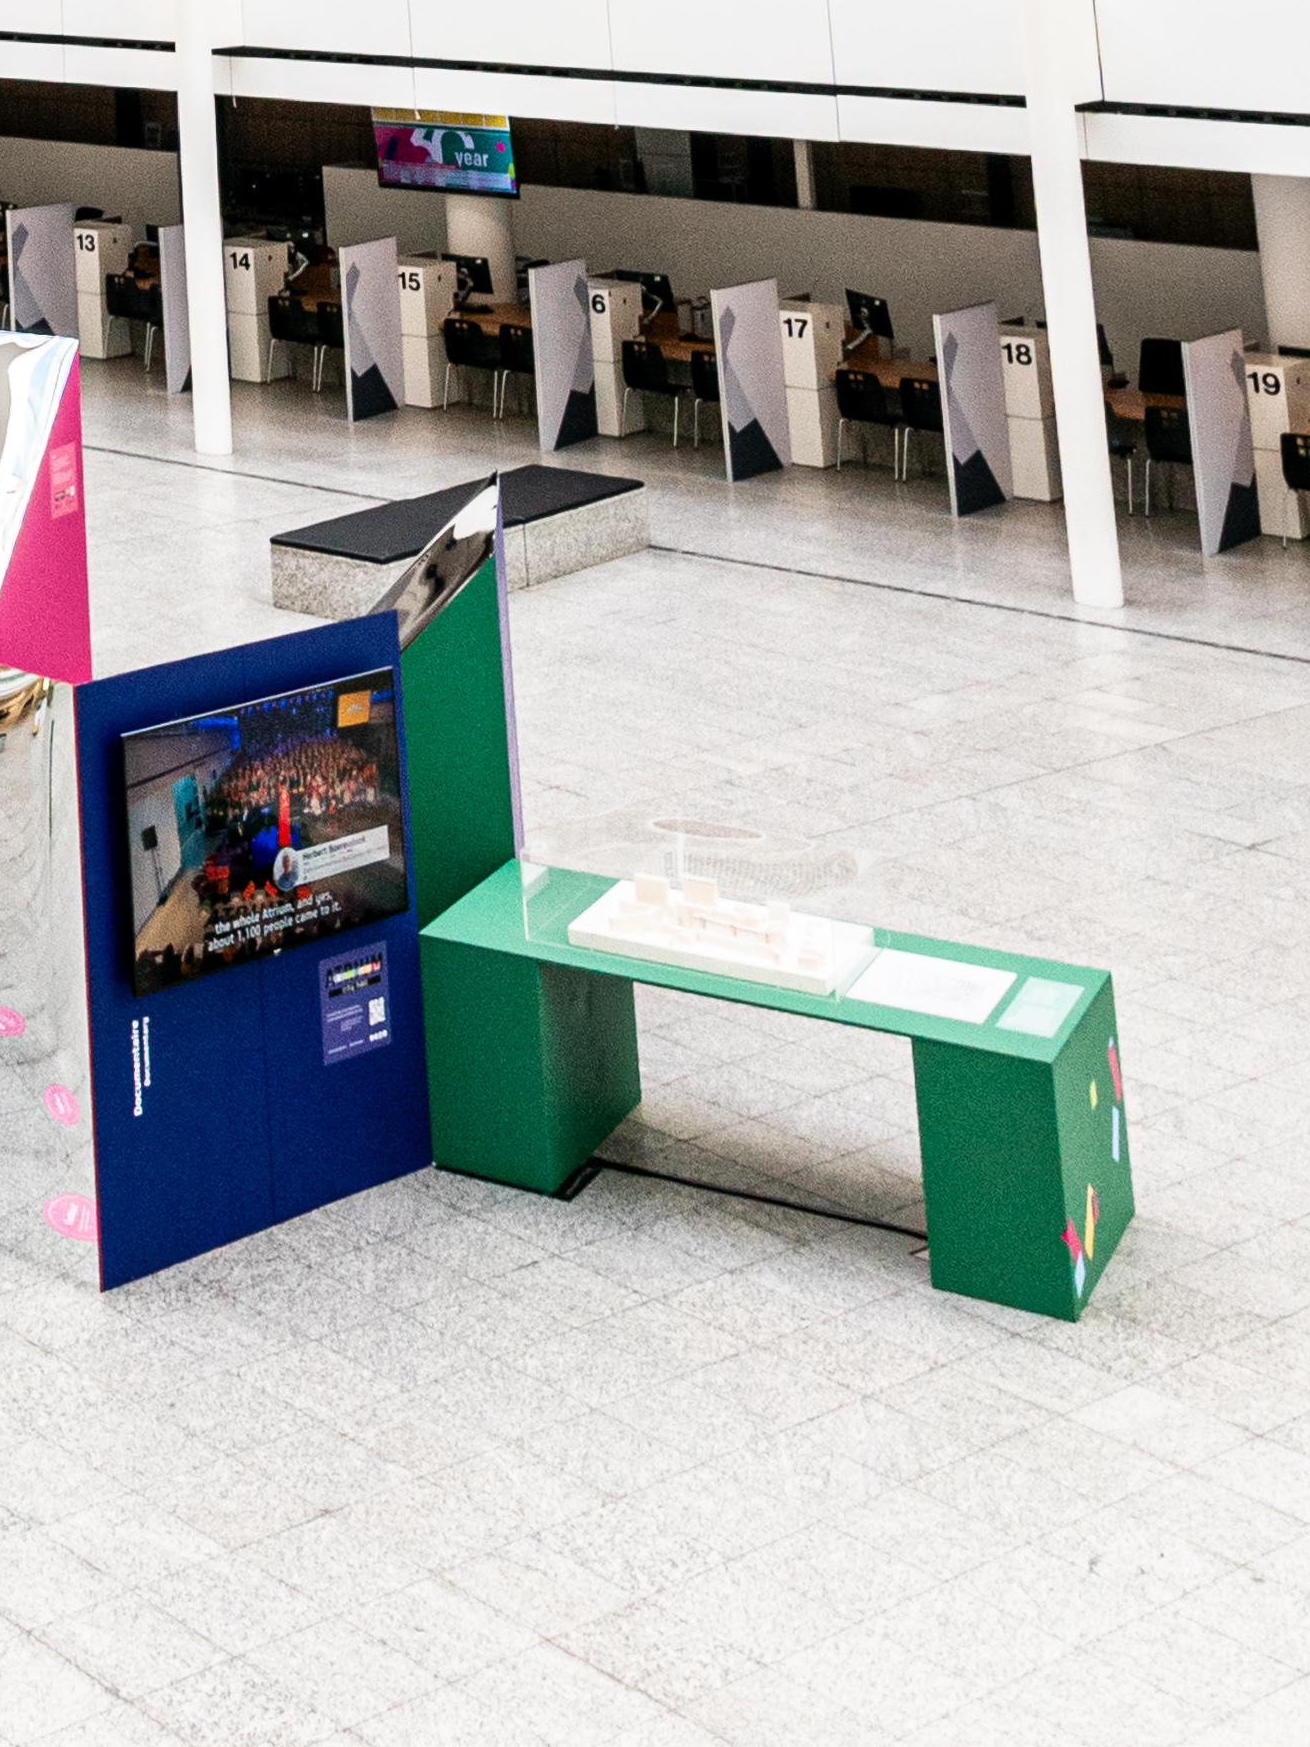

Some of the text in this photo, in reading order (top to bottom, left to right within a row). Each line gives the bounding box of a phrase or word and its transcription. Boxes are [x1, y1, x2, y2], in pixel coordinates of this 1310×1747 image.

[454, 150, 489, 168] year
[76, 233, 96, 252] 13
[229, 251, 251, 271] 14
[398, 271, 421, 292] 15
[782, 317, 808, 339] 17
[1001, 343, 1033, 365] 18
[1246, 372, 1281, 396] 19
[214, 920, 230, 935] the
[233, 912, 260, 929] whole
[297, 896, 313, 910] and
[208, 936, 235, 952] about
[237, 926, 262, 943] 1,100
[263, 917, 294, 935] people
[295, 911, 318, 925] came
[320, 905, 330, 916] to
[142, 1016, 151, 1087] Documentary
[130, 1019, 143, 1117] Documentaire
